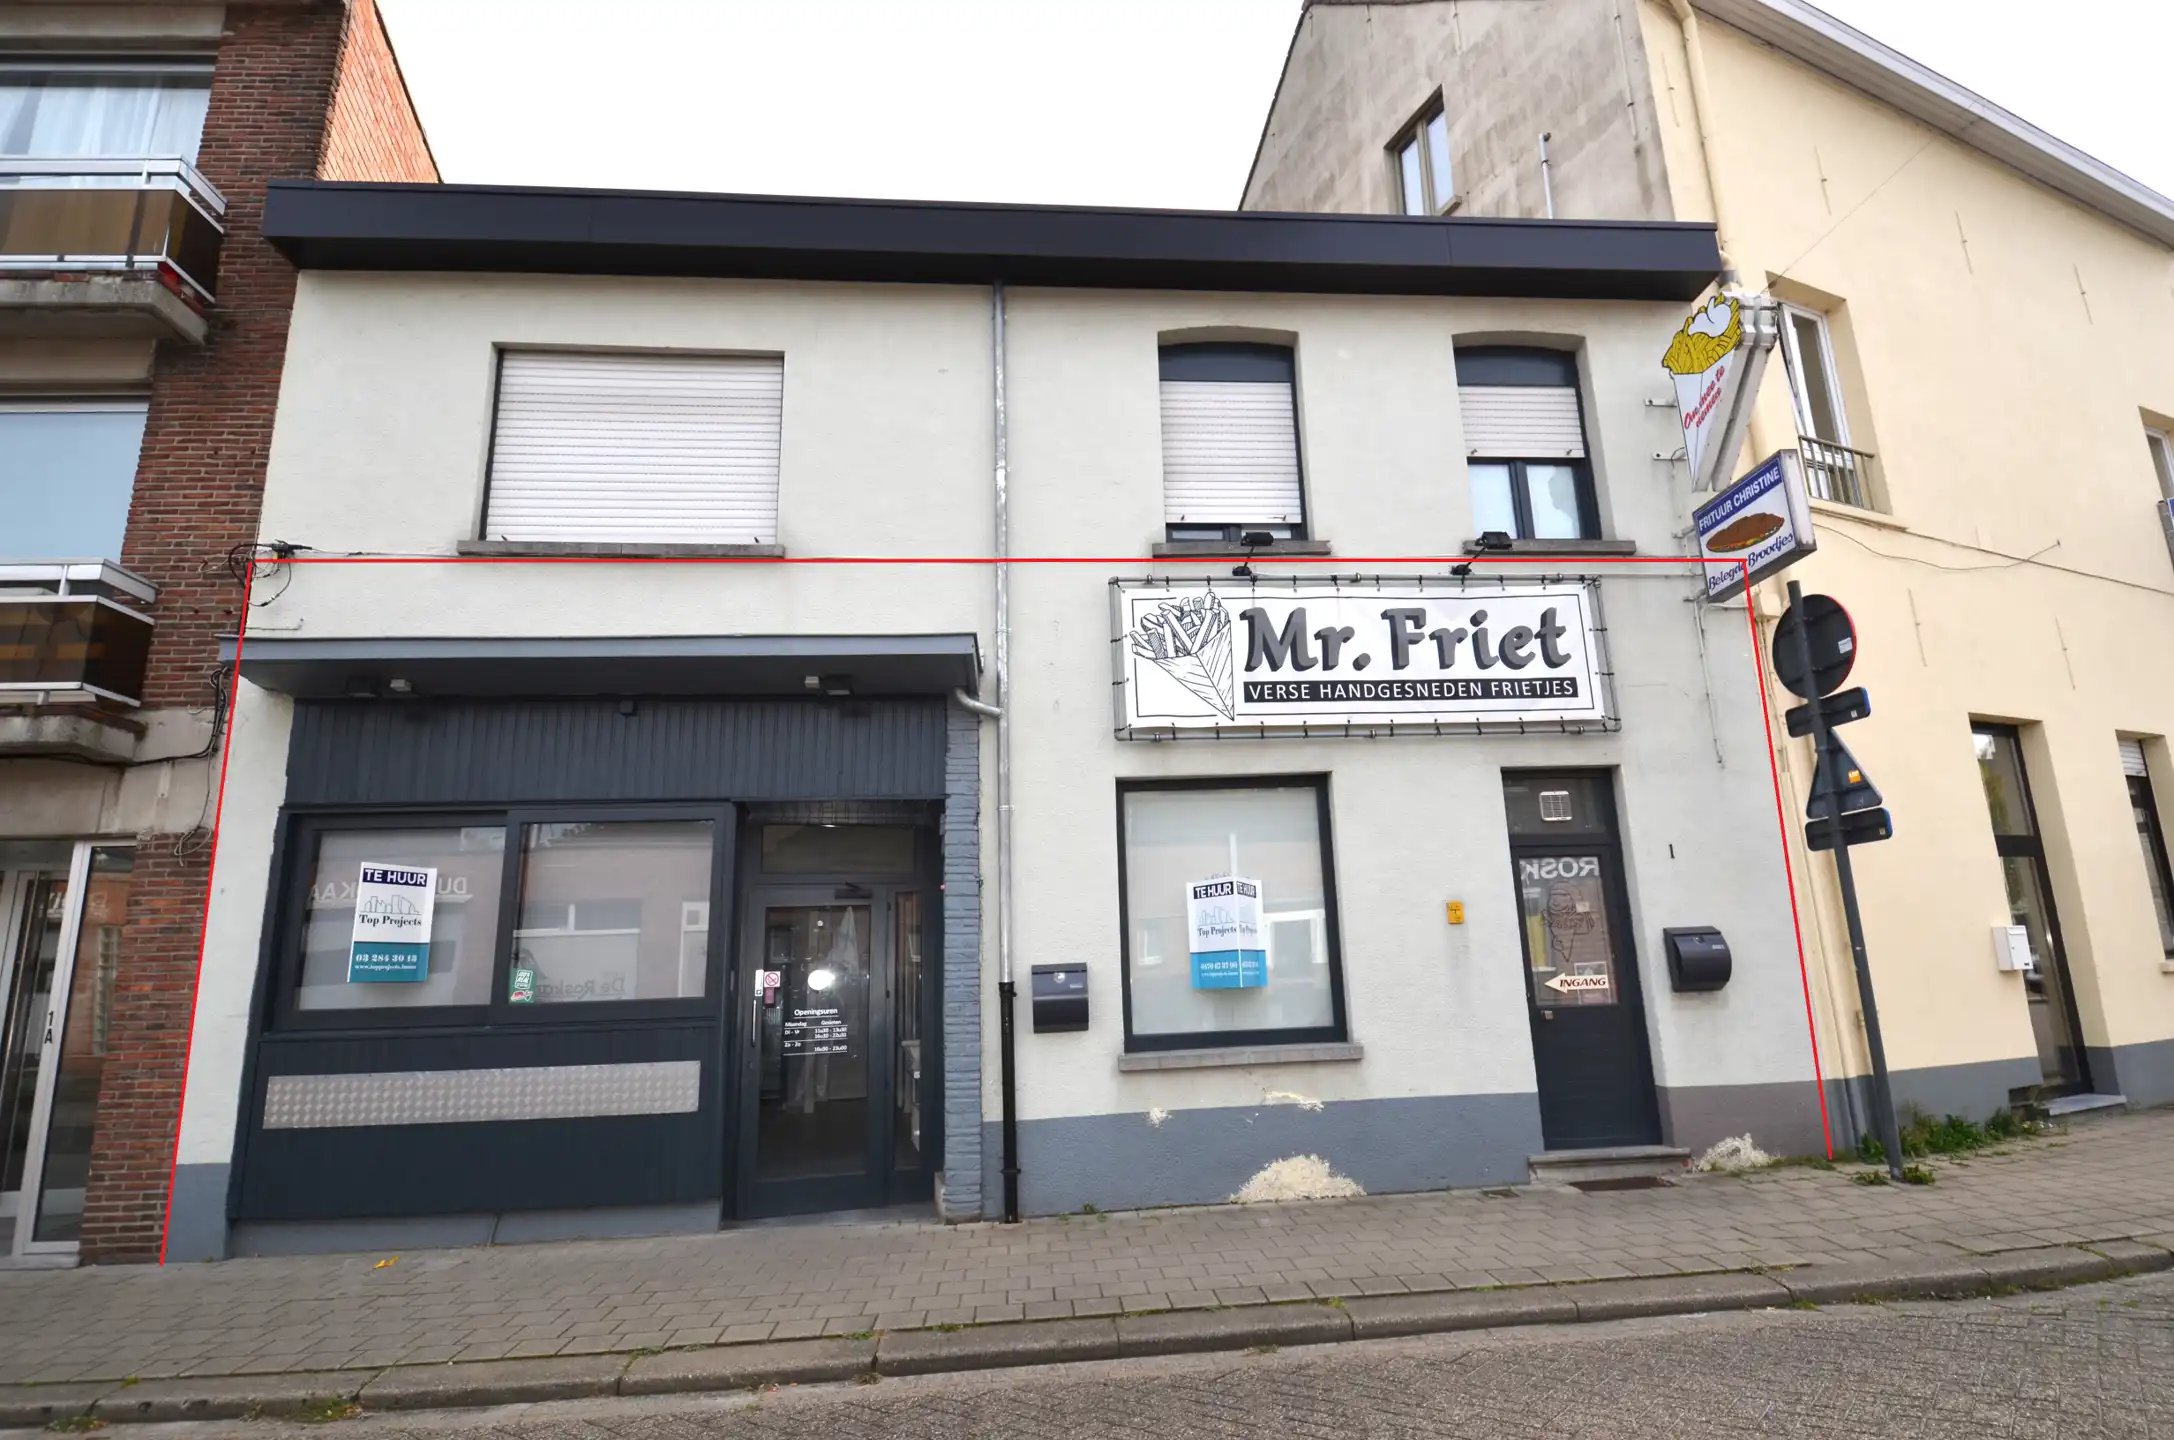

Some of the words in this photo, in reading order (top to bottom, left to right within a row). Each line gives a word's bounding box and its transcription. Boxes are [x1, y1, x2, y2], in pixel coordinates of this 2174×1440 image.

[1699, 500, 1733, 531] FRITUUR
[1733, 467, 1780, 507] CHRISTINE
[1708, 562, 1746, 590] Belegd
[1748, 533, 1794, 567] Broodjes
[1240, 607, 1371, 672] Mr.
[1381, 607, 1572, 671] Friet
[1249, 682, 1311, 700] VERSE
[1320, 680, 1483, 699] HANDGESNEDEN
[1491, 679, 1574, 698] FRIETJES
[365, 869, 383, 882] TE
[387, 871, 426, 885] HUUR
[1195, 887, 1206, 899] TE
[1207, 883, 1232, 897] HUUR
[359, 914, 379, 928] Top
[382, 915, 422, 928] Projects
[1198, 927, 1210, 938] Top
[1210, 925, 1237, 937] Projects
[355, 954, 369, 962] 03
[392, 954, 404, 962] 30
[1559, 978, 1606, 988] INGANG
[794, 1008, 838, 1016] Openingsuren
